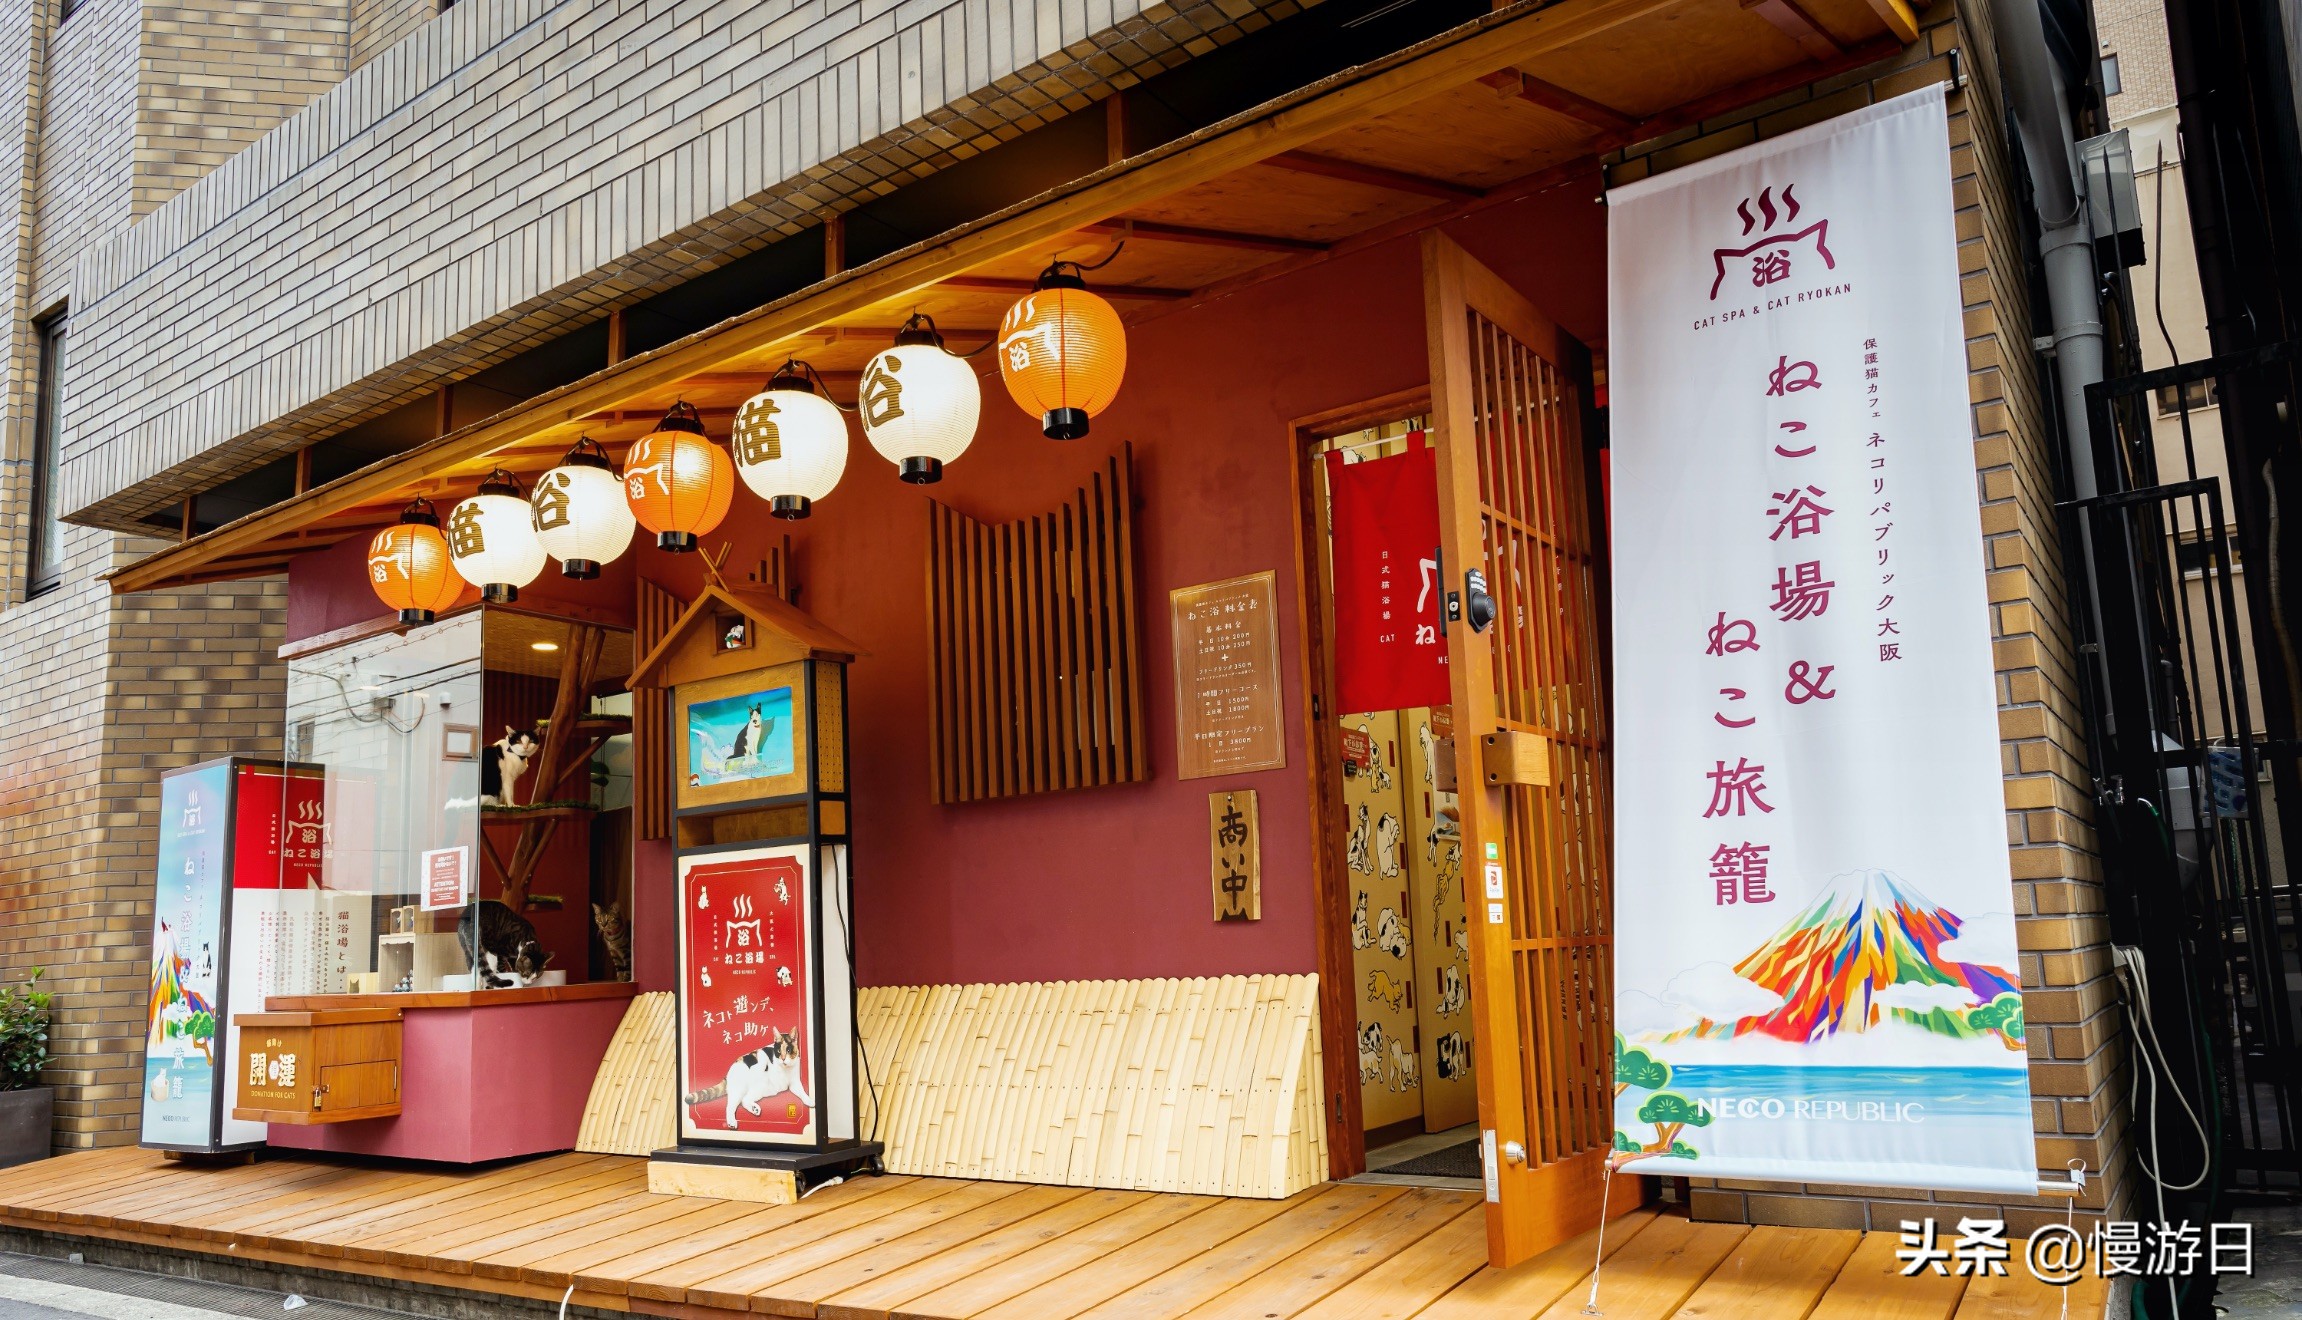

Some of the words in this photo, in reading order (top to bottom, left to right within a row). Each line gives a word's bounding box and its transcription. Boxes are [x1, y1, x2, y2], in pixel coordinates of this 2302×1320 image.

[1752, 250, 1791, 288] 浴
[1694, 316, 1716, 331] CAT
[1722, 309, 1746, 323] SPA
[1753, 305, 1760, 315] &
[1767, 296, 1791, 311] CAT
[1798, 283, 1851, 303] RYOKAN
[1008, 341, 1030, 373] 浴
[630, 476, 645, 500] 浴
[373, 563, 388, 583] 浴
[1380, 633, 1395, 643] CAT
[1702, 611, 1776, 906] ねこ旅籠
[302, 828, 317, 844] 浴
[1218, 804, 1249, 911] 商い中
[737, 928, 750, 947] 浴
[251, 1090, 274, 1098] DONATION
[274, 1091, 283, 1099] FOR
[284, 1091, 296, 1099] CATS
[1793, 1099, 1926, 1124] REPUBLIC
